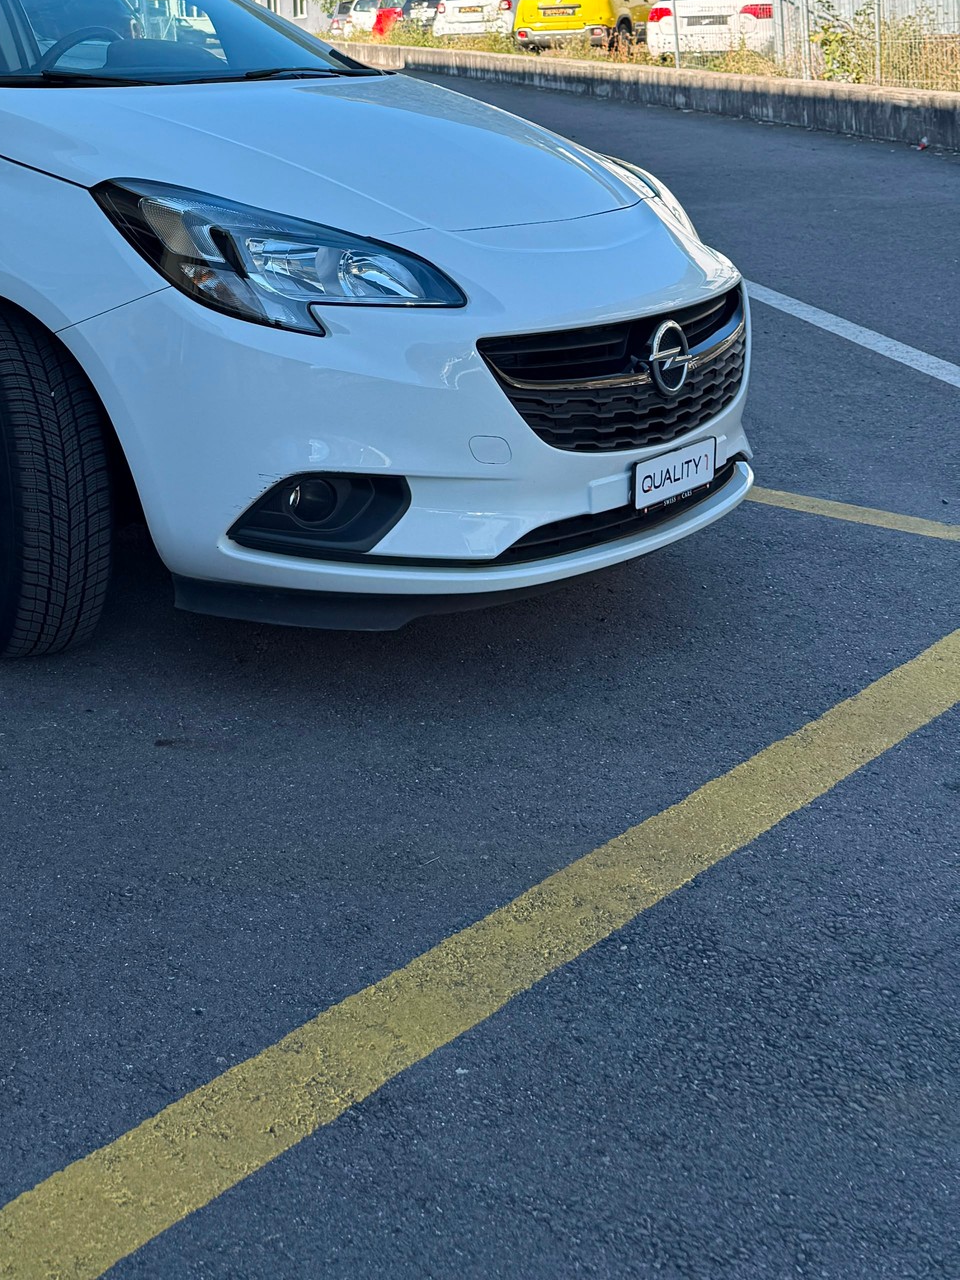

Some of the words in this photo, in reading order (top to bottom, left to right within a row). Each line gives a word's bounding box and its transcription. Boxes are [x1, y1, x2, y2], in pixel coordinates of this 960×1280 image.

[641, 455, 702, 494] QUALITY
[663, 496, 677, 507] SWISS
[681, 490, 693, 499] CARS
